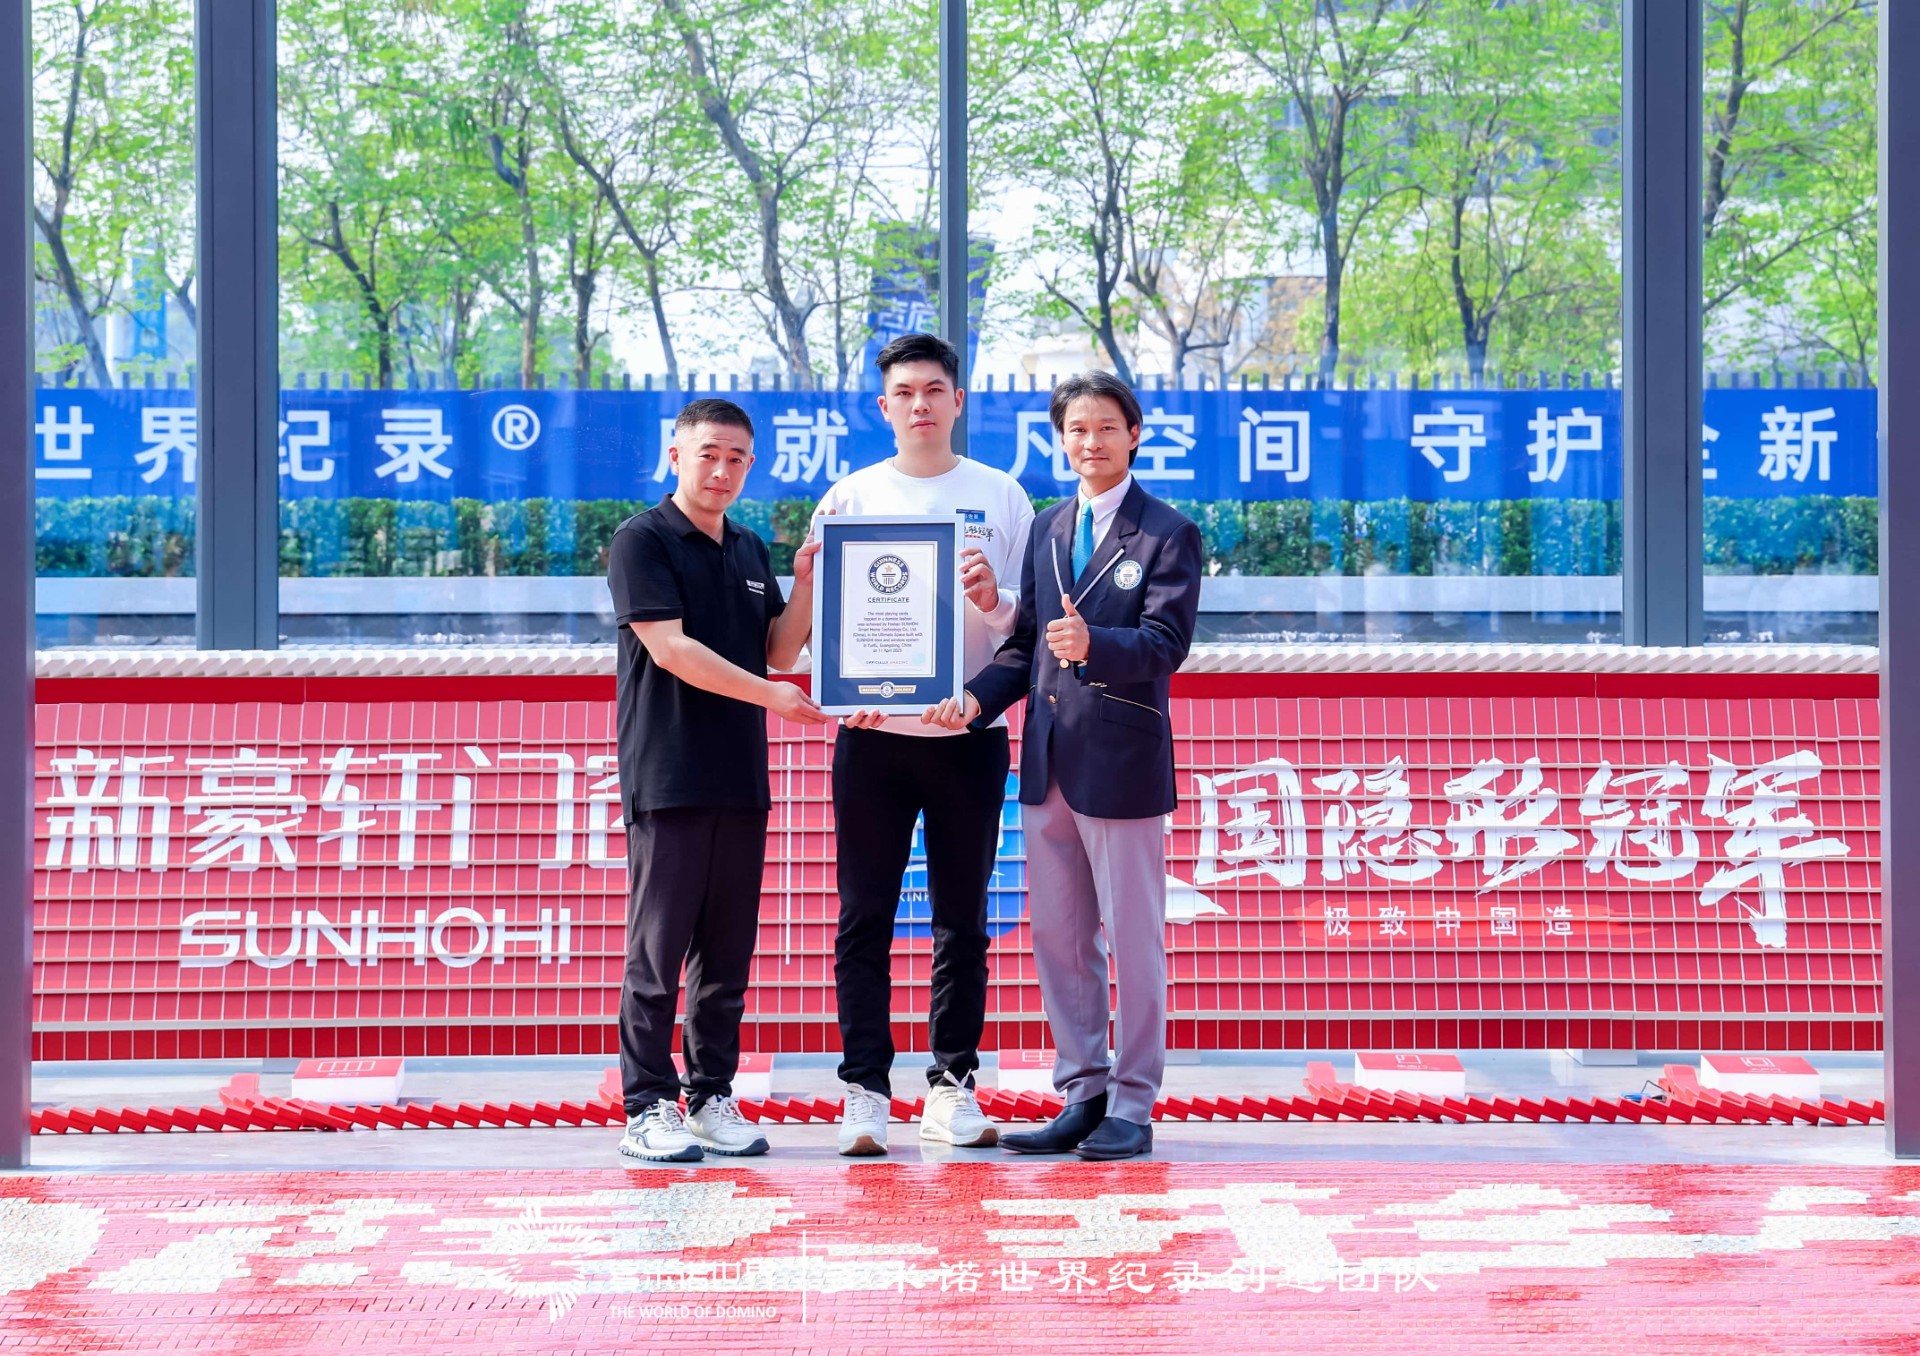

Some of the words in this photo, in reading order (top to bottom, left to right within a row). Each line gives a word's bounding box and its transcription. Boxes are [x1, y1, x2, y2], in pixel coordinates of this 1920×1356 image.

[179, 907, 571, 968] SUNHOHI
[1323, 905, 1576, 938] 极致中国造
